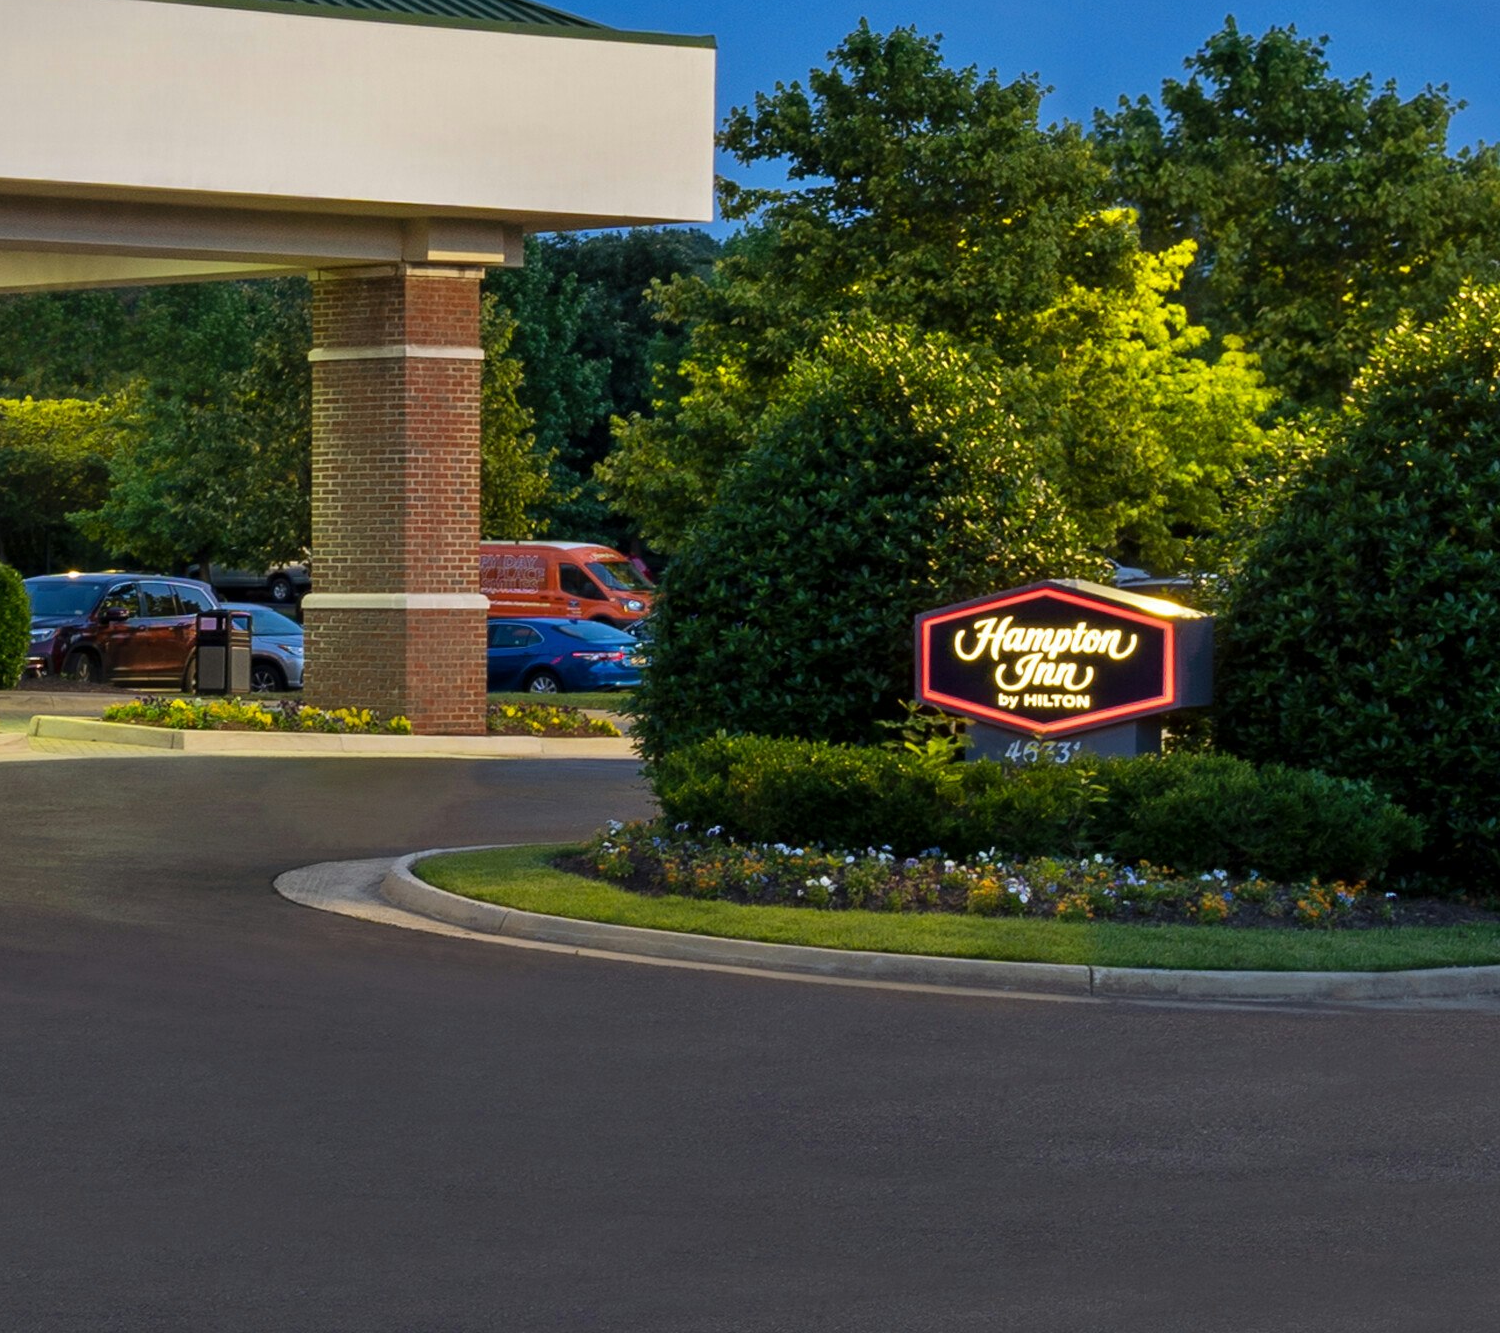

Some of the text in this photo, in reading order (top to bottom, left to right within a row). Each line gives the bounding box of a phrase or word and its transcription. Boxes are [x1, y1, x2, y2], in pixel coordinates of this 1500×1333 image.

[503, 554, 538, 570] DAY
[954, 615, 1138, 661] Hampton
[995, 651, 1094, 691] Inn
[998, 693, 1090, 709] by HILTON
